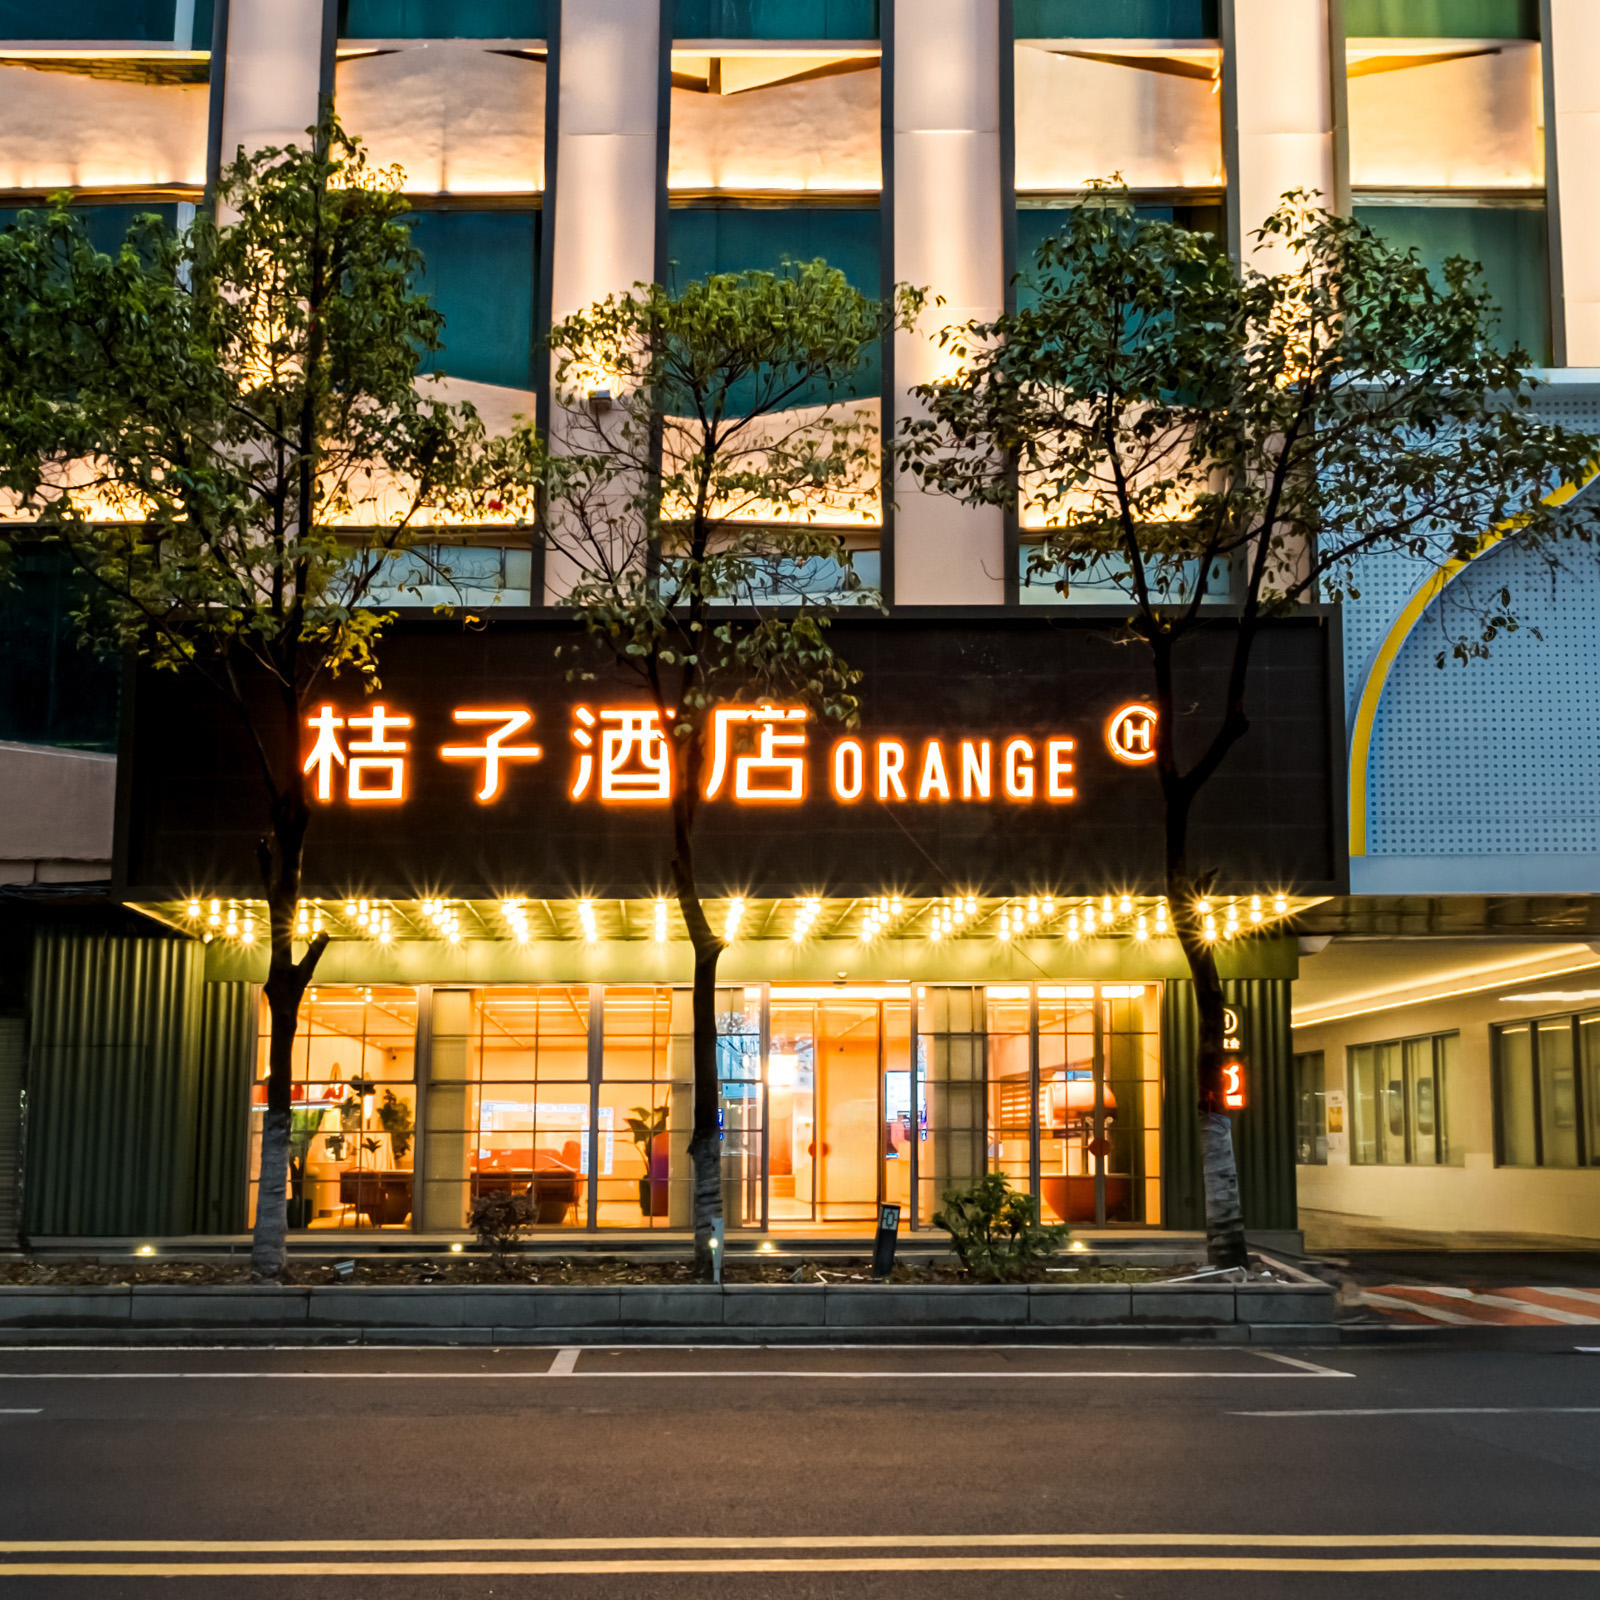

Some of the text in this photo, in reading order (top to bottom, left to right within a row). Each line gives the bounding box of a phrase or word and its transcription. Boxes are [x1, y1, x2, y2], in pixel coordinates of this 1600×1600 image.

[303, 705, 807, 803] 桔子酒店
[833, 738, 1075, 802] ORANGE
